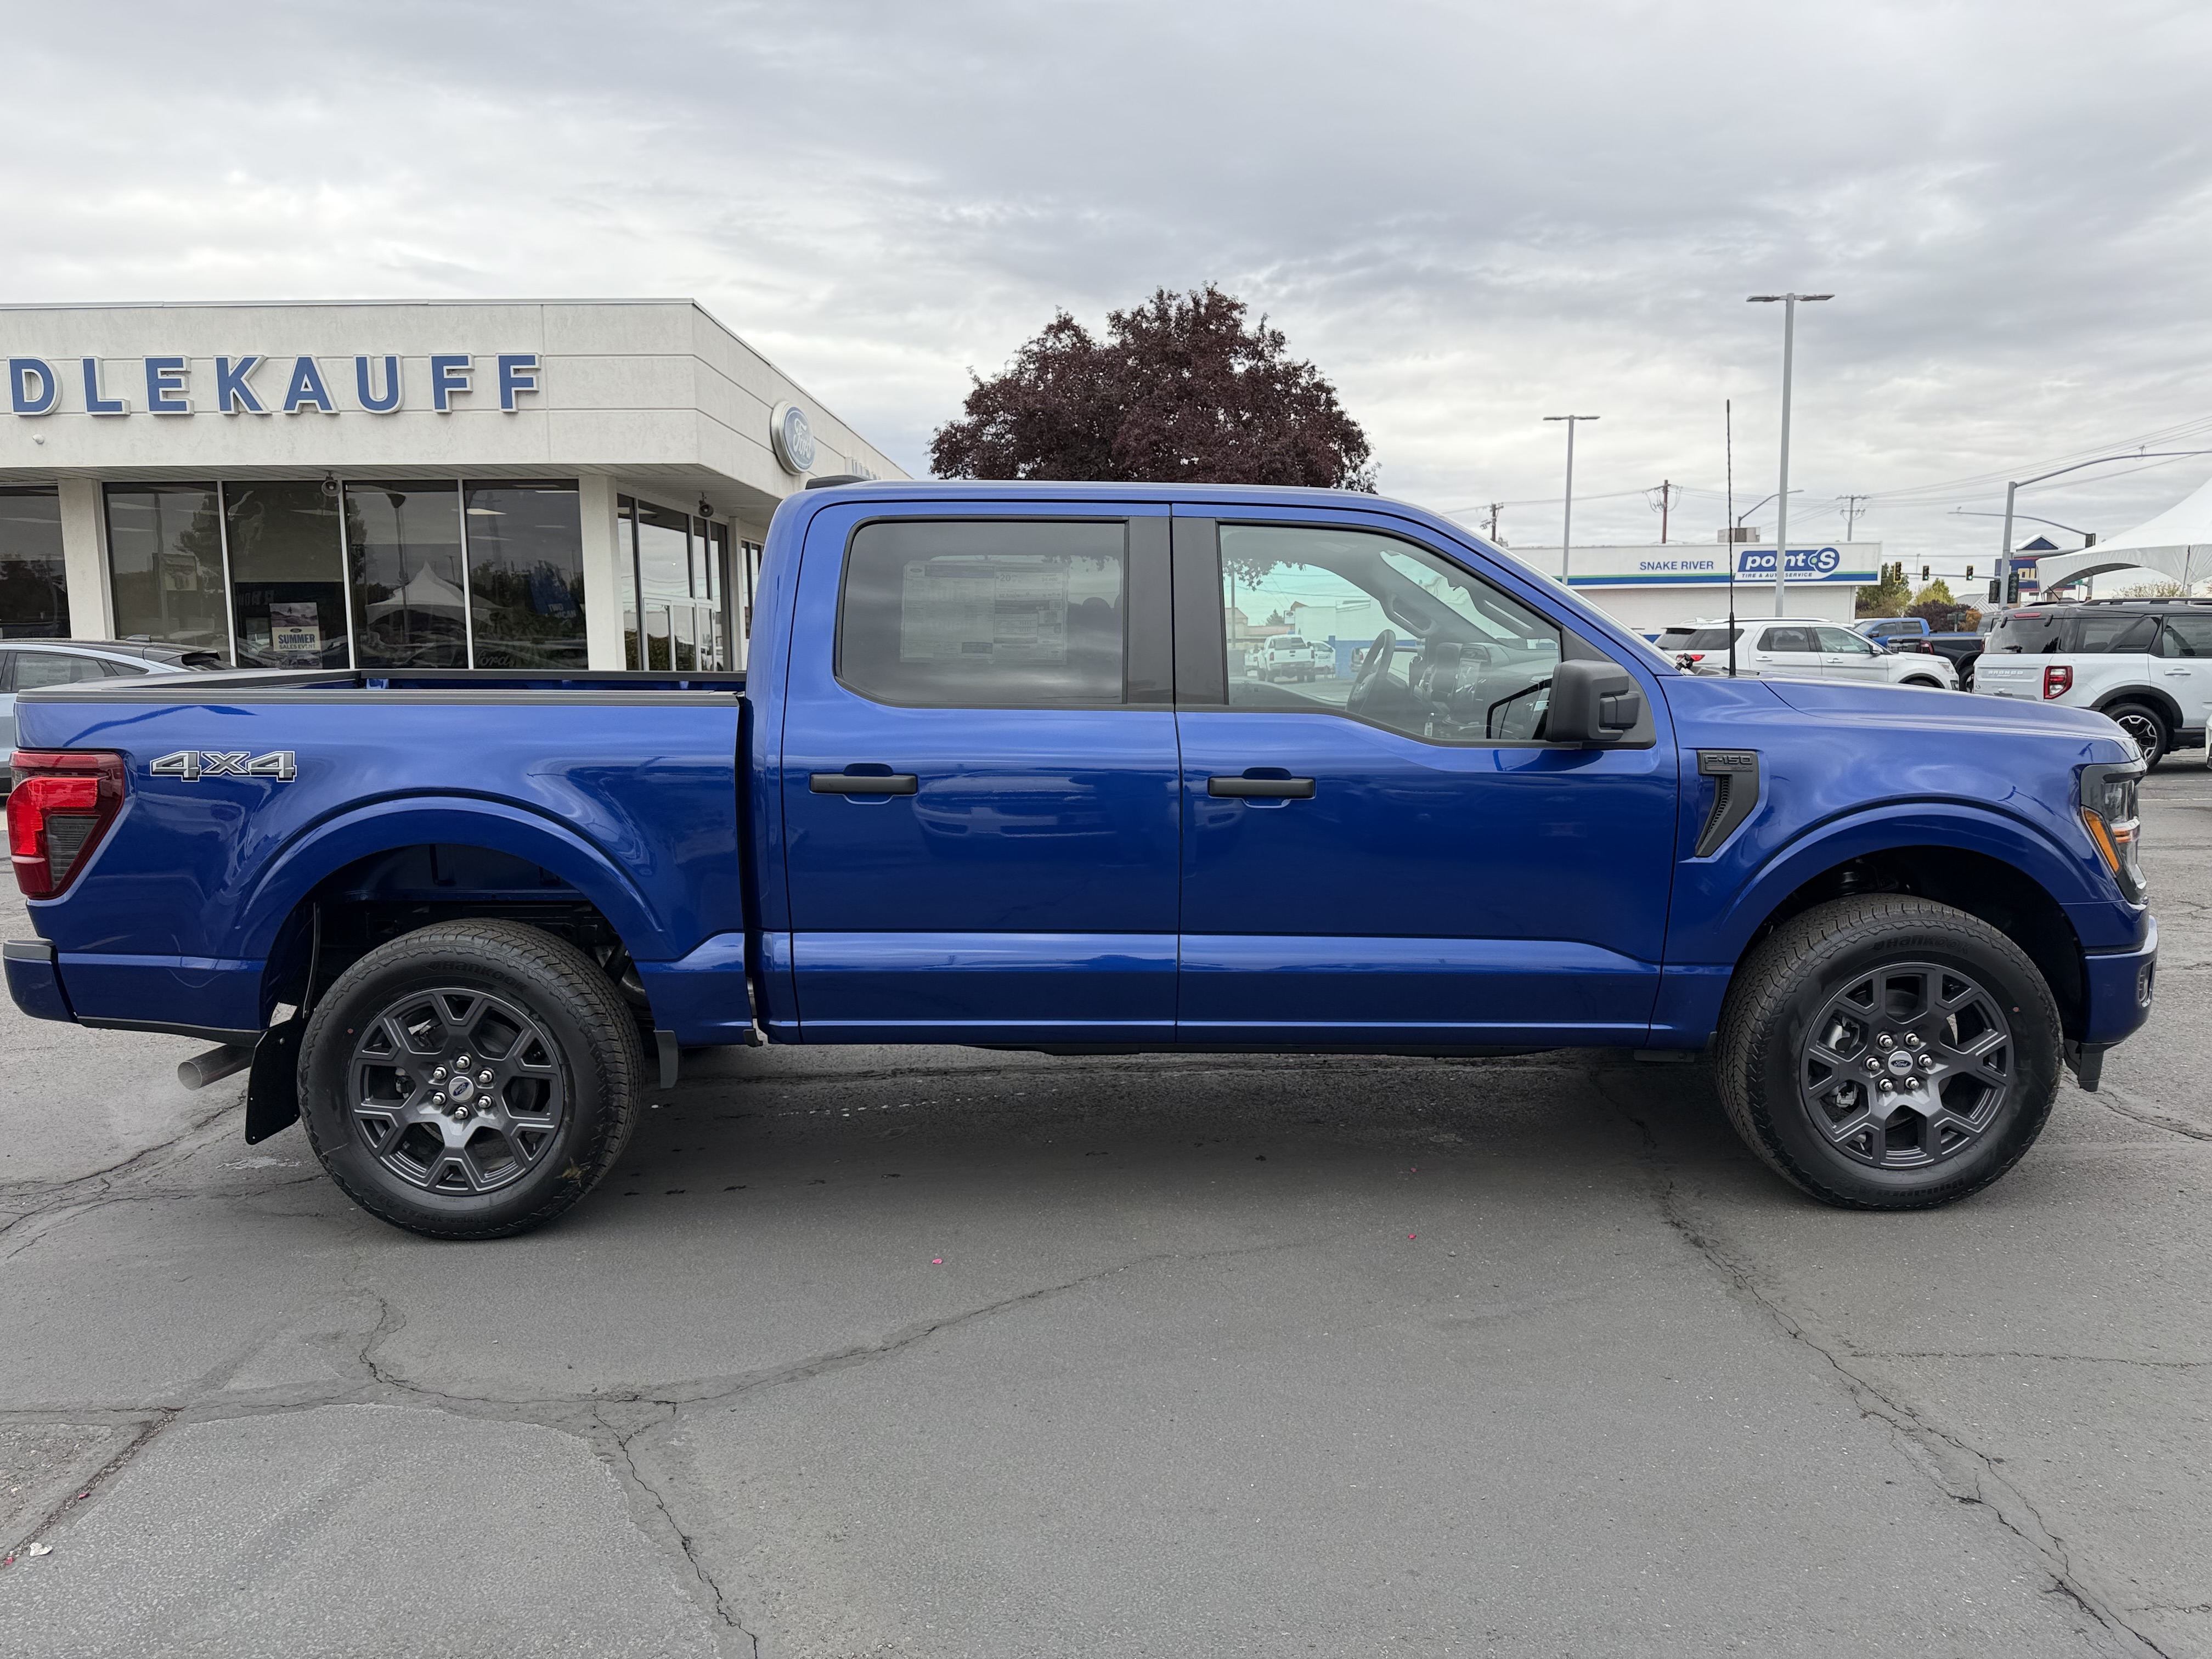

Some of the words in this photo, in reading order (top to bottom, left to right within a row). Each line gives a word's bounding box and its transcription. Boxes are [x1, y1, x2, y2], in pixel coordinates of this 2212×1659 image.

[7, 352, 541, 416] DLEKAUFF
[793, 417, 812, 459] Ford
[1639, 561, 1678, 571] SNAKE
[1681, 561, 1714, 570] RIVER
[1746, 552, 1806, 570] pont
[548, 603, 564, 612] TWO
[278, 634, 315, 644] SUMMER
[1705, 755, 1753, 765] F-150
